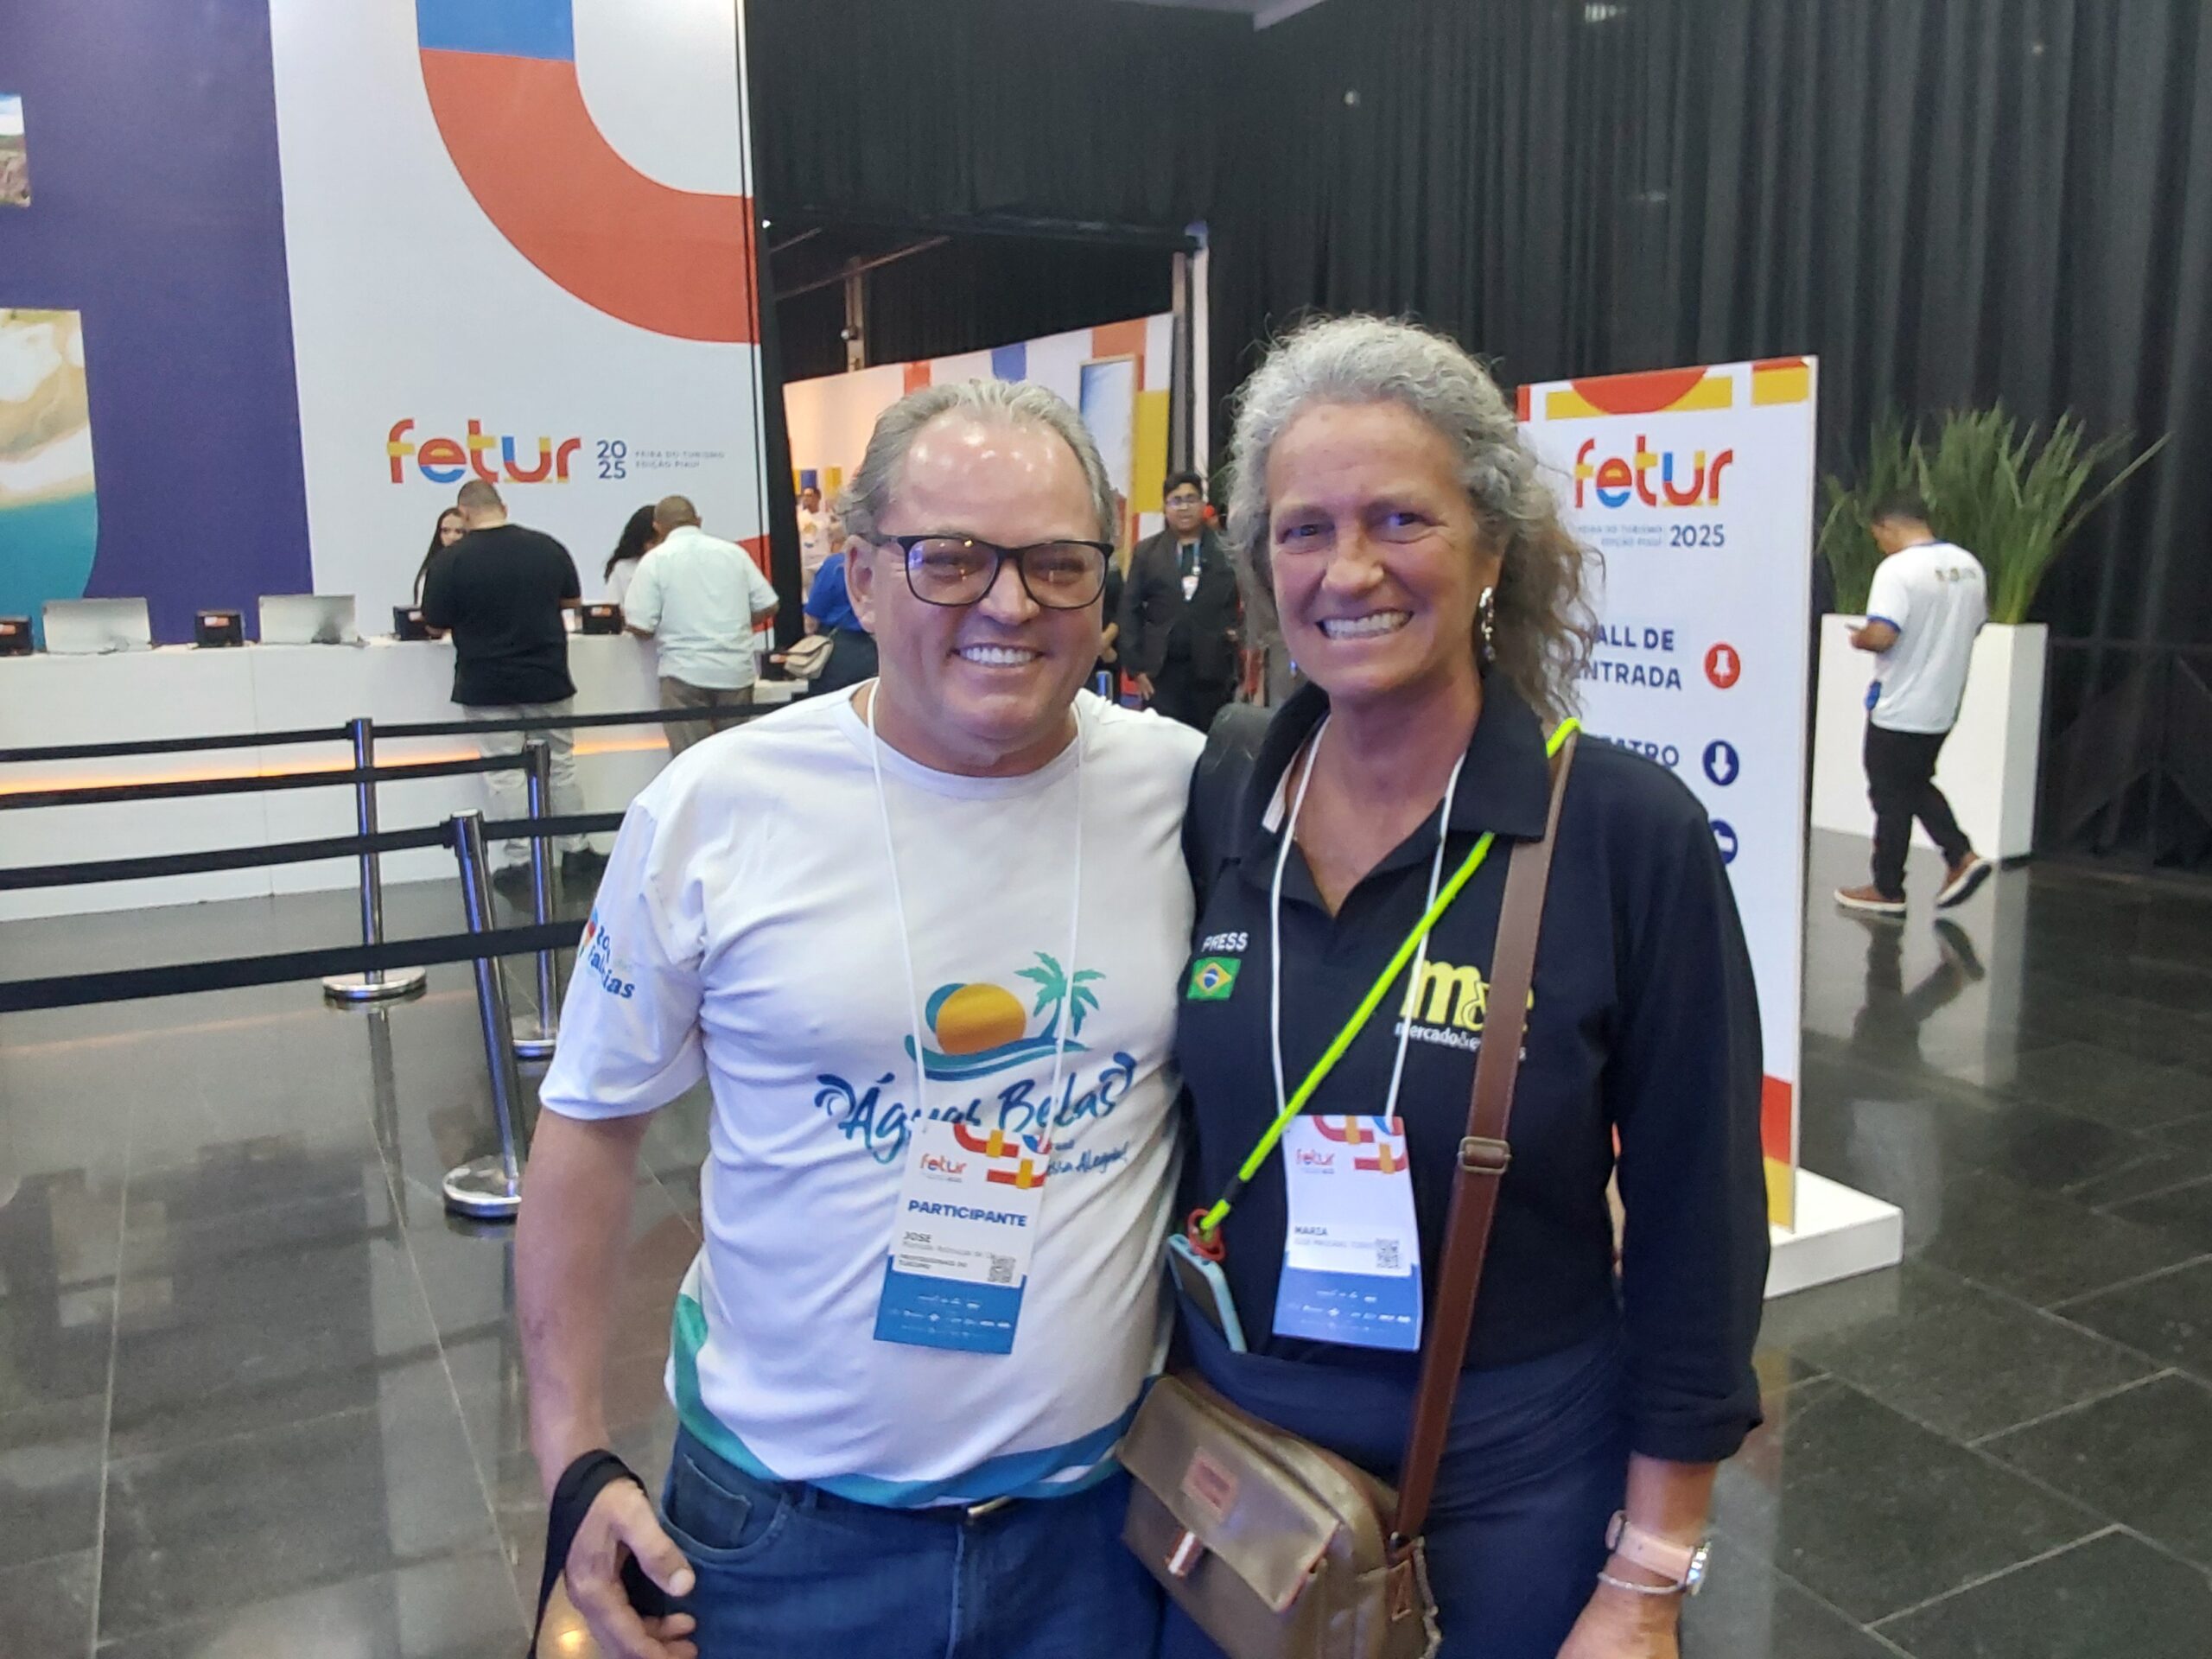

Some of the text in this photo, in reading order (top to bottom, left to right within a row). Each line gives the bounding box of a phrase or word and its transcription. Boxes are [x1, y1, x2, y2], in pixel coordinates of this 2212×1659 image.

[387, 418, 582, 483] fetur
[596, 440, 627, 459] 20
[598, 461, 627, 480] 25
[1574, 435, 1733, 508] fetur
[1669, 524, 1725, 547] 2025
[1595, 625, 1675, 651] ALL DE
[1583, 660, 1681, 690] NTRADA
[1201, 932, 1249, 952] PRESS
[919, 1153, 968, 1174] fetur
[908, 1199, 1027, 1227] PARTICIPANTE
[1294, 1226, 1328, 1236] MARIA
